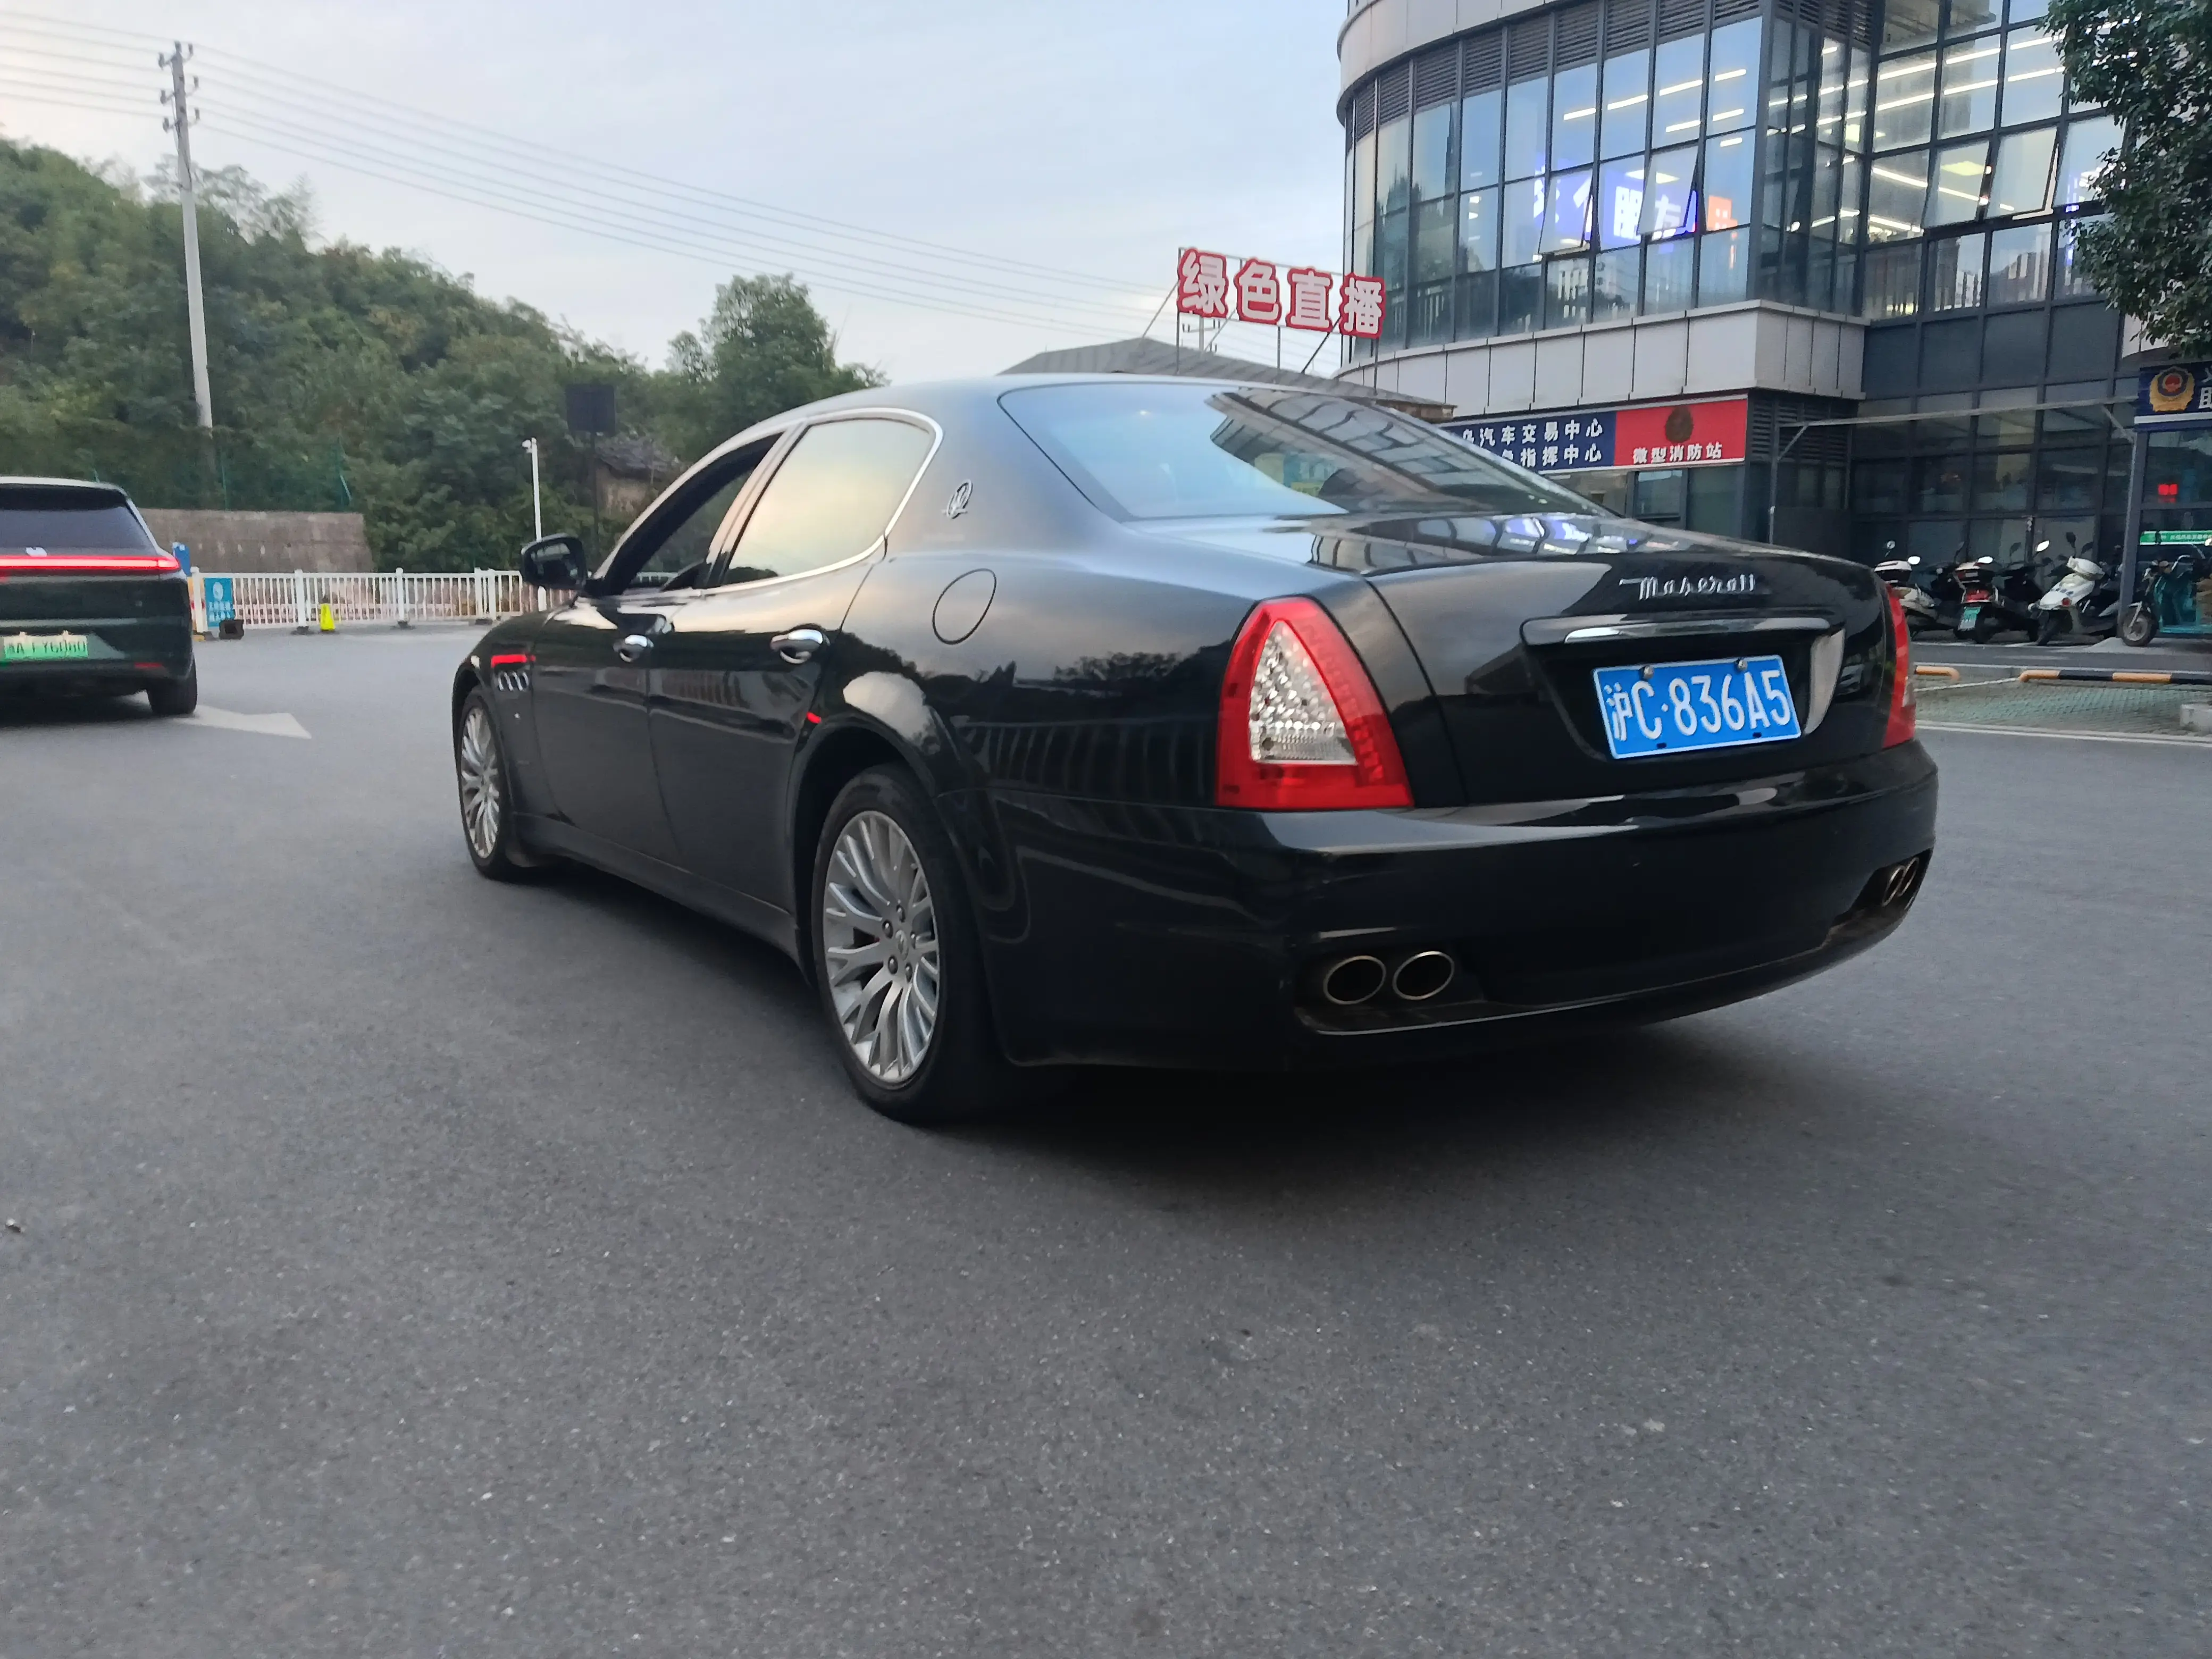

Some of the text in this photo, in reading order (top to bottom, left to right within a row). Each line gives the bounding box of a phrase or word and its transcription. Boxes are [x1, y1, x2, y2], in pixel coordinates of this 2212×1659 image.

[1178, 249, 1384, 337] 绿色直播
[1463, 418, 1603, 447] 乌汽车交易中心
[1633, 441, 1722, 465] 微型消防站
[1604, 669, 1791, 741] 沪C·836A5
